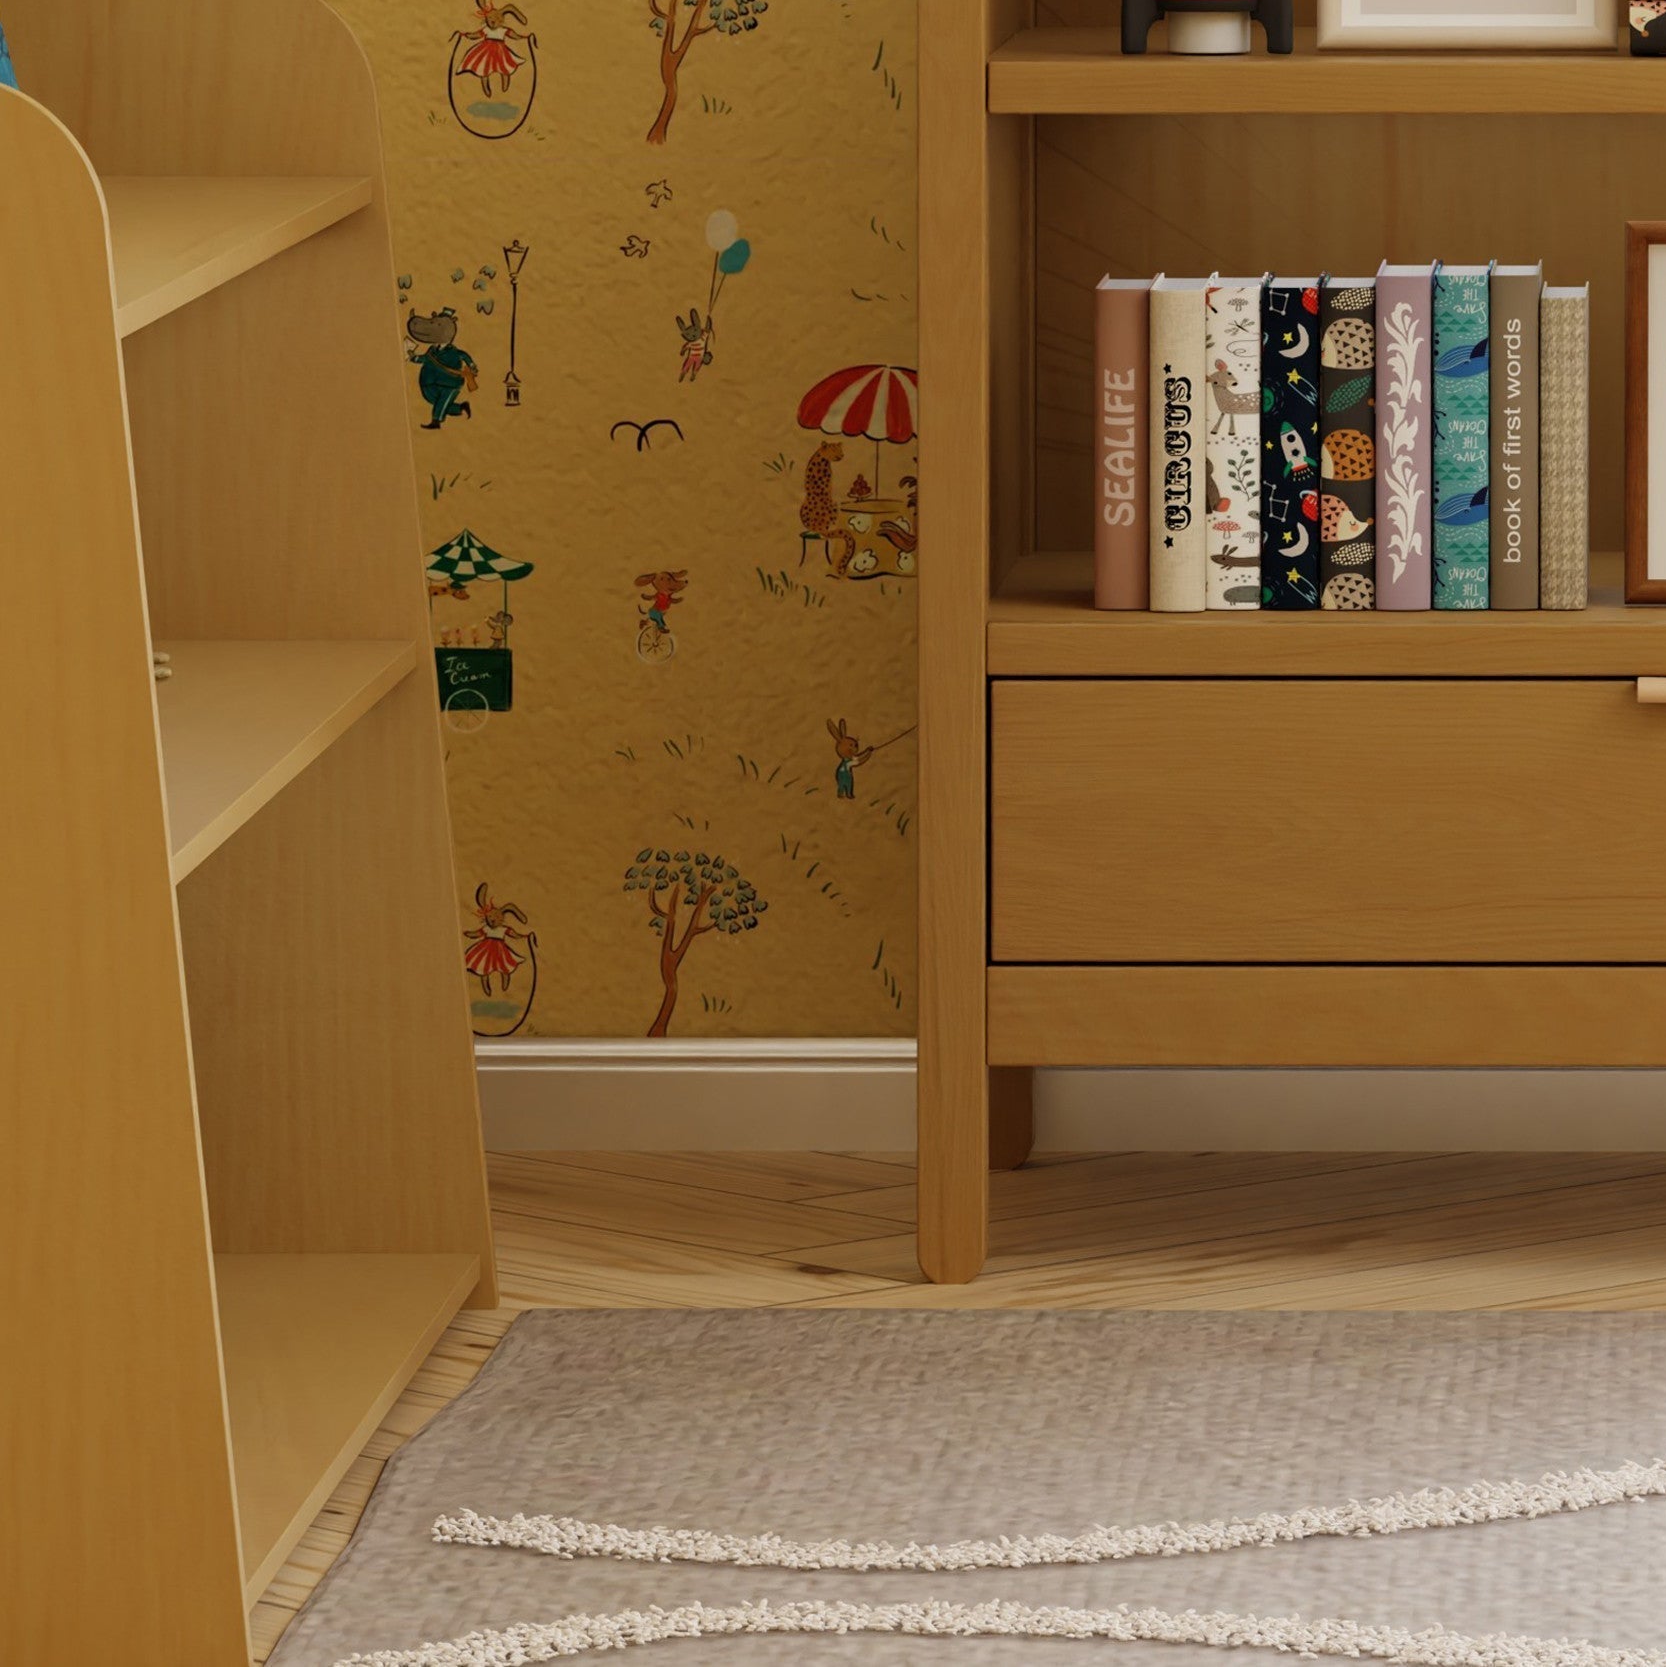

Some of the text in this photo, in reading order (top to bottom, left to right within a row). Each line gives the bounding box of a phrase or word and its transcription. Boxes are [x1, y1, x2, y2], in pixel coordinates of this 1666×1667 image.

[1462, 288, 1479, 301] THE
[1104, 368, 1135, 526] SEALIFE
[1164, 376, 1192, 531] CIRCUS
[1462, 436, 1479, 449] THE
[1503, 318, 1521, 563] book of first words
[1462, 583, 1479, 596] THE
